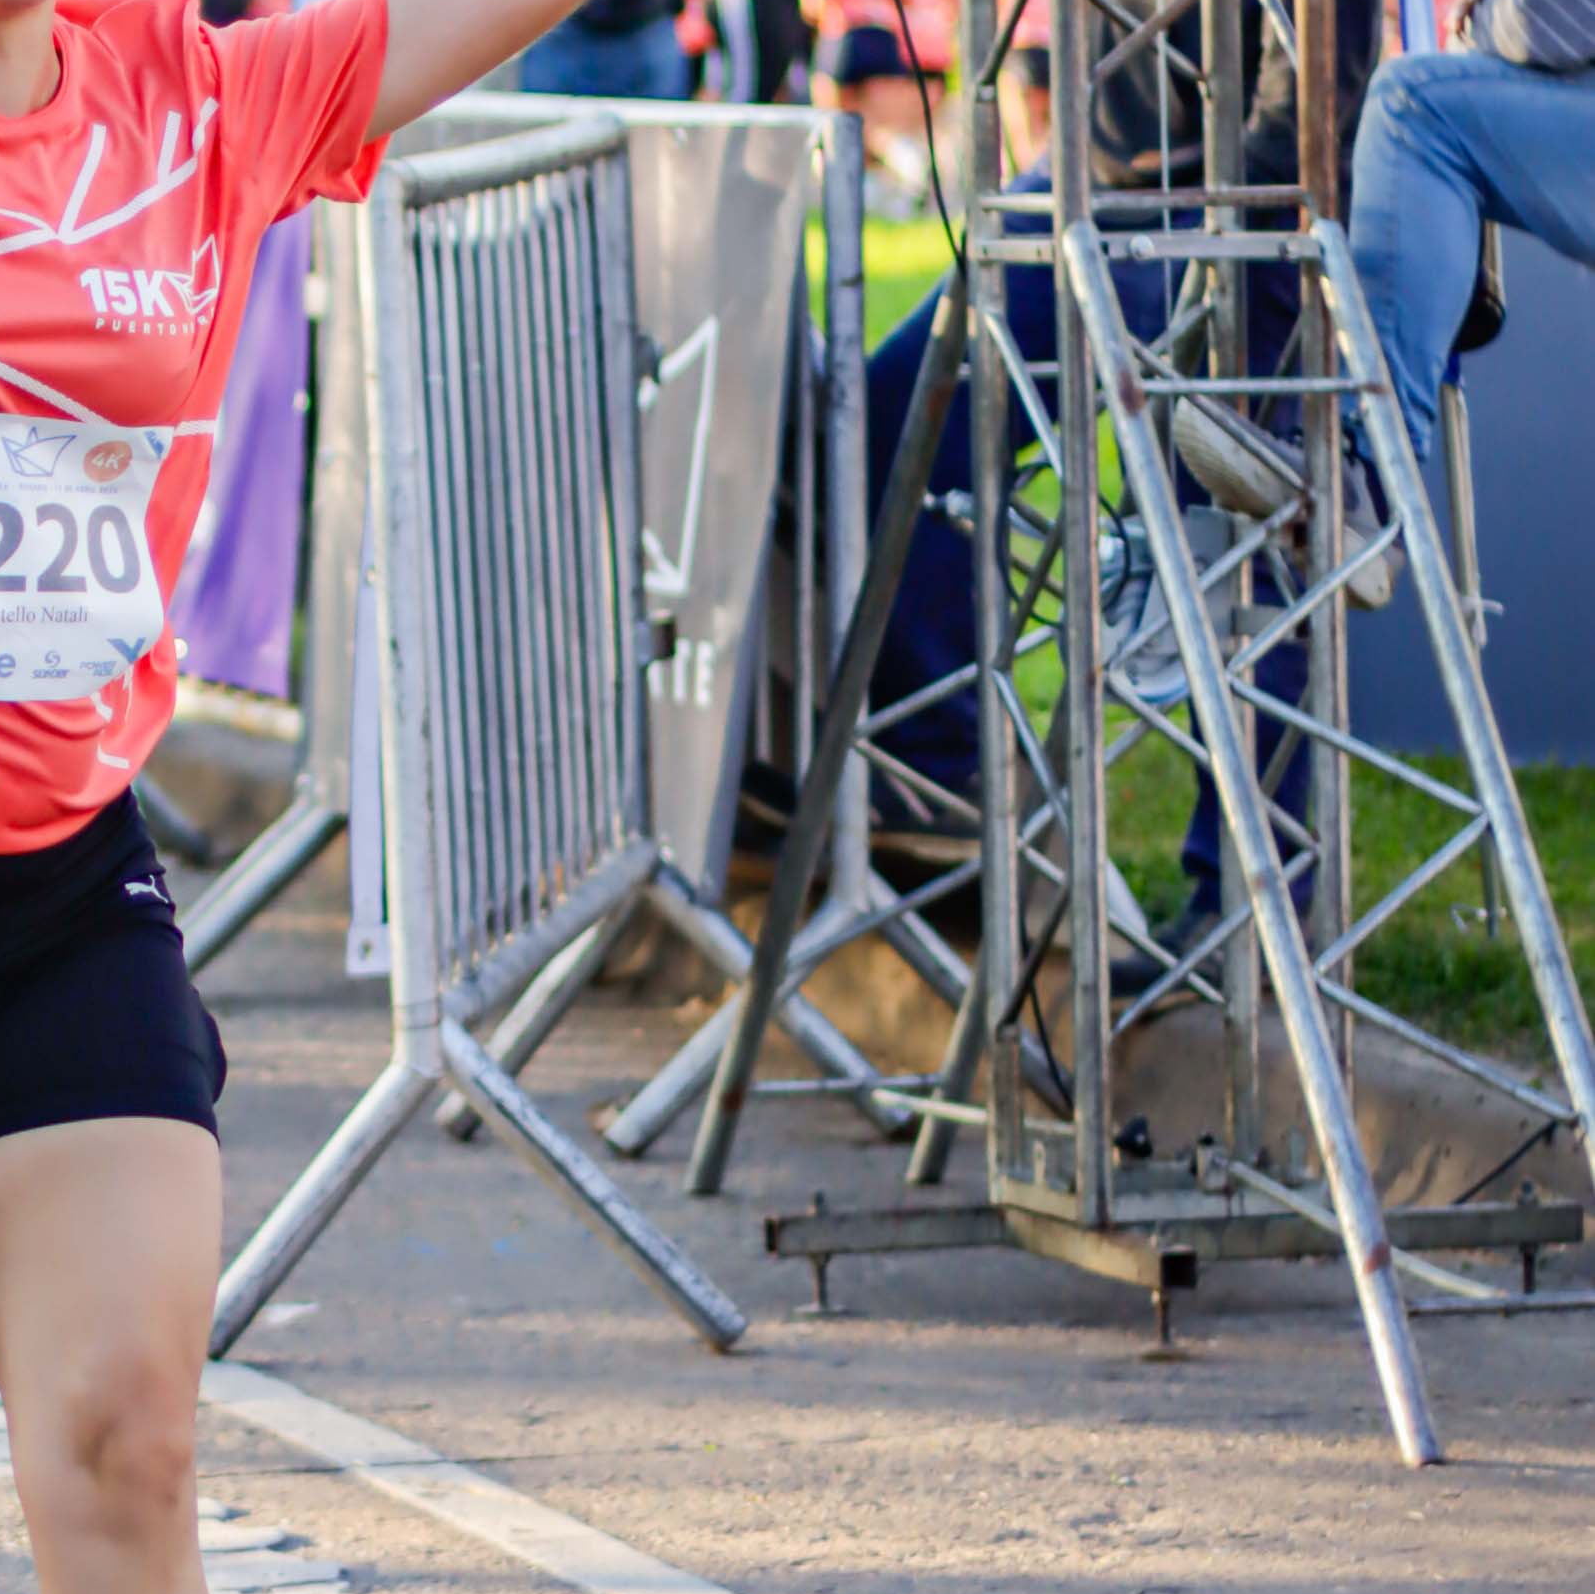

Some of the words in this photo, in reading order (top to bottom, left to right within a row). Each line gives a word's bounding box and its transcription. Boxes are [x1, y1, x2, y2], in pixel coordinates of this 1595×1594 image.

[80, 268, 174, 317] 15K
[91, 451, 123, 471] 4K
[41, 605, 88, 624] Natali
